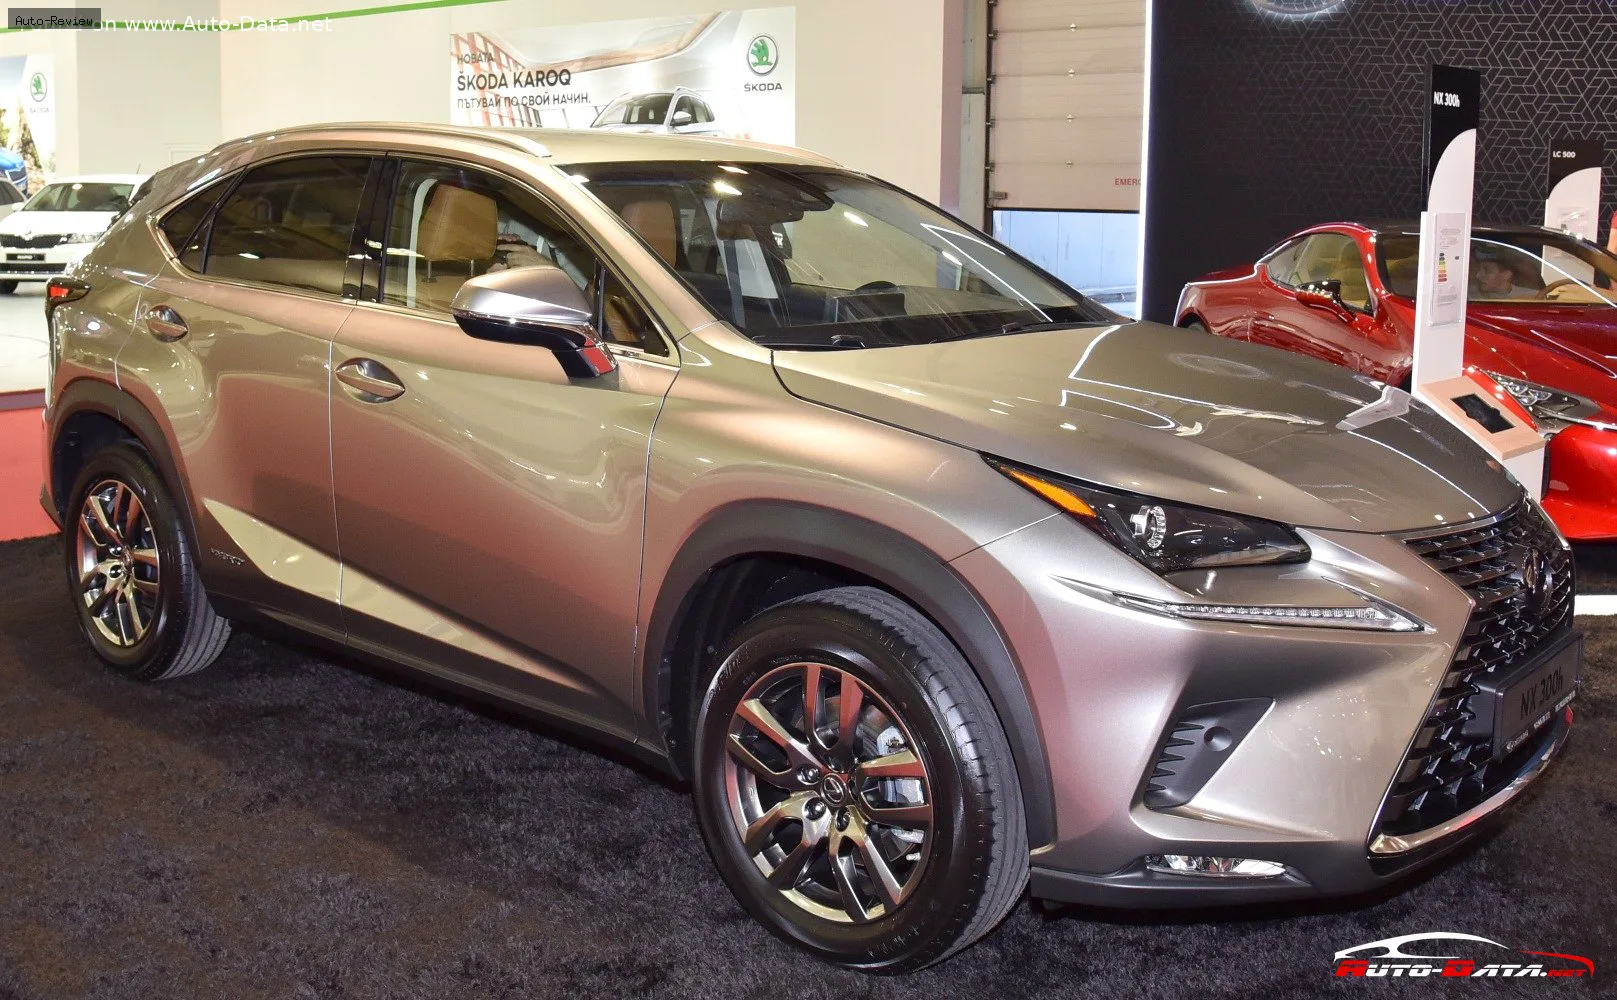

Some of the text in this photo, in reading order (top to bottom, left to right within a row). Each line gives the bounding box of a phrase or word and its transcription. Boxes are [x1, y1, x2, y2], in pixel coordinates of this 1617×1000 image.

[457, 52, 494, 65] НОВАТА
[457, 68, 571, 92] ŠKODA KAROQ
[457, 91, 591, 109] ПЪТУВАЙ ПО СВОЙ НАЧИН.
[1433, 91, 1460, 108] NX 300h
[1552, 150, 1576, 159] LC 500
[1520, 683, 1537, 721] NX
[1540, 665, 1563, 706] 300h
